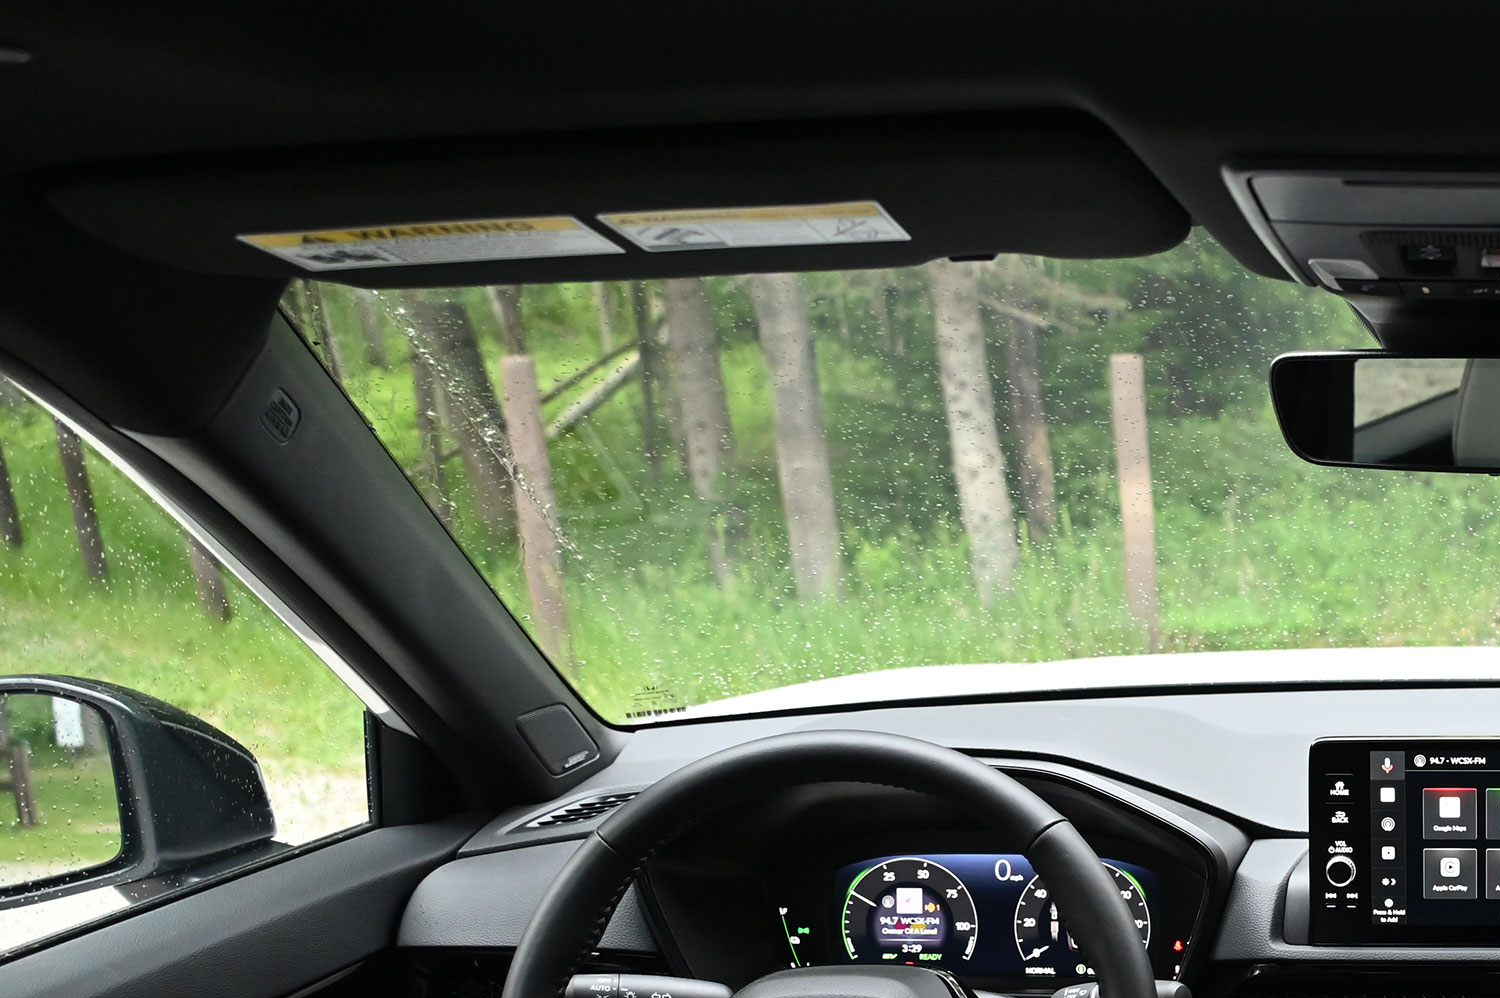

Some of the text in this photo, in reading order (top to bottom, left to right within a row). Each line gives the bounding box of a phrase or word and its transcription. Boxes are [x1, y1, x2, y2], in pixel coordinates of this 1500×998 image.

[350, 221, 536, 240] WARNING
[1430, 757, 1445, 765] 94.7
[1450, 757, 1486, 765] WCSX-FM
[917, 869, 930, 880] 50
[994, 859, 1011, 881] 0
[883, 871, 896, 882] 25
[945, 889, 958, 899] 75
[1034, 889, 1047, 898] 40
[880, 917, 940, 925] 94.7 WCSX-FM
[1023, 918, 1036, 928] 20
[955, 922, 971, 931] 100
[902, 944, 923, 953] 3:29
[1025, 967, 1056, 975] NORMAL
